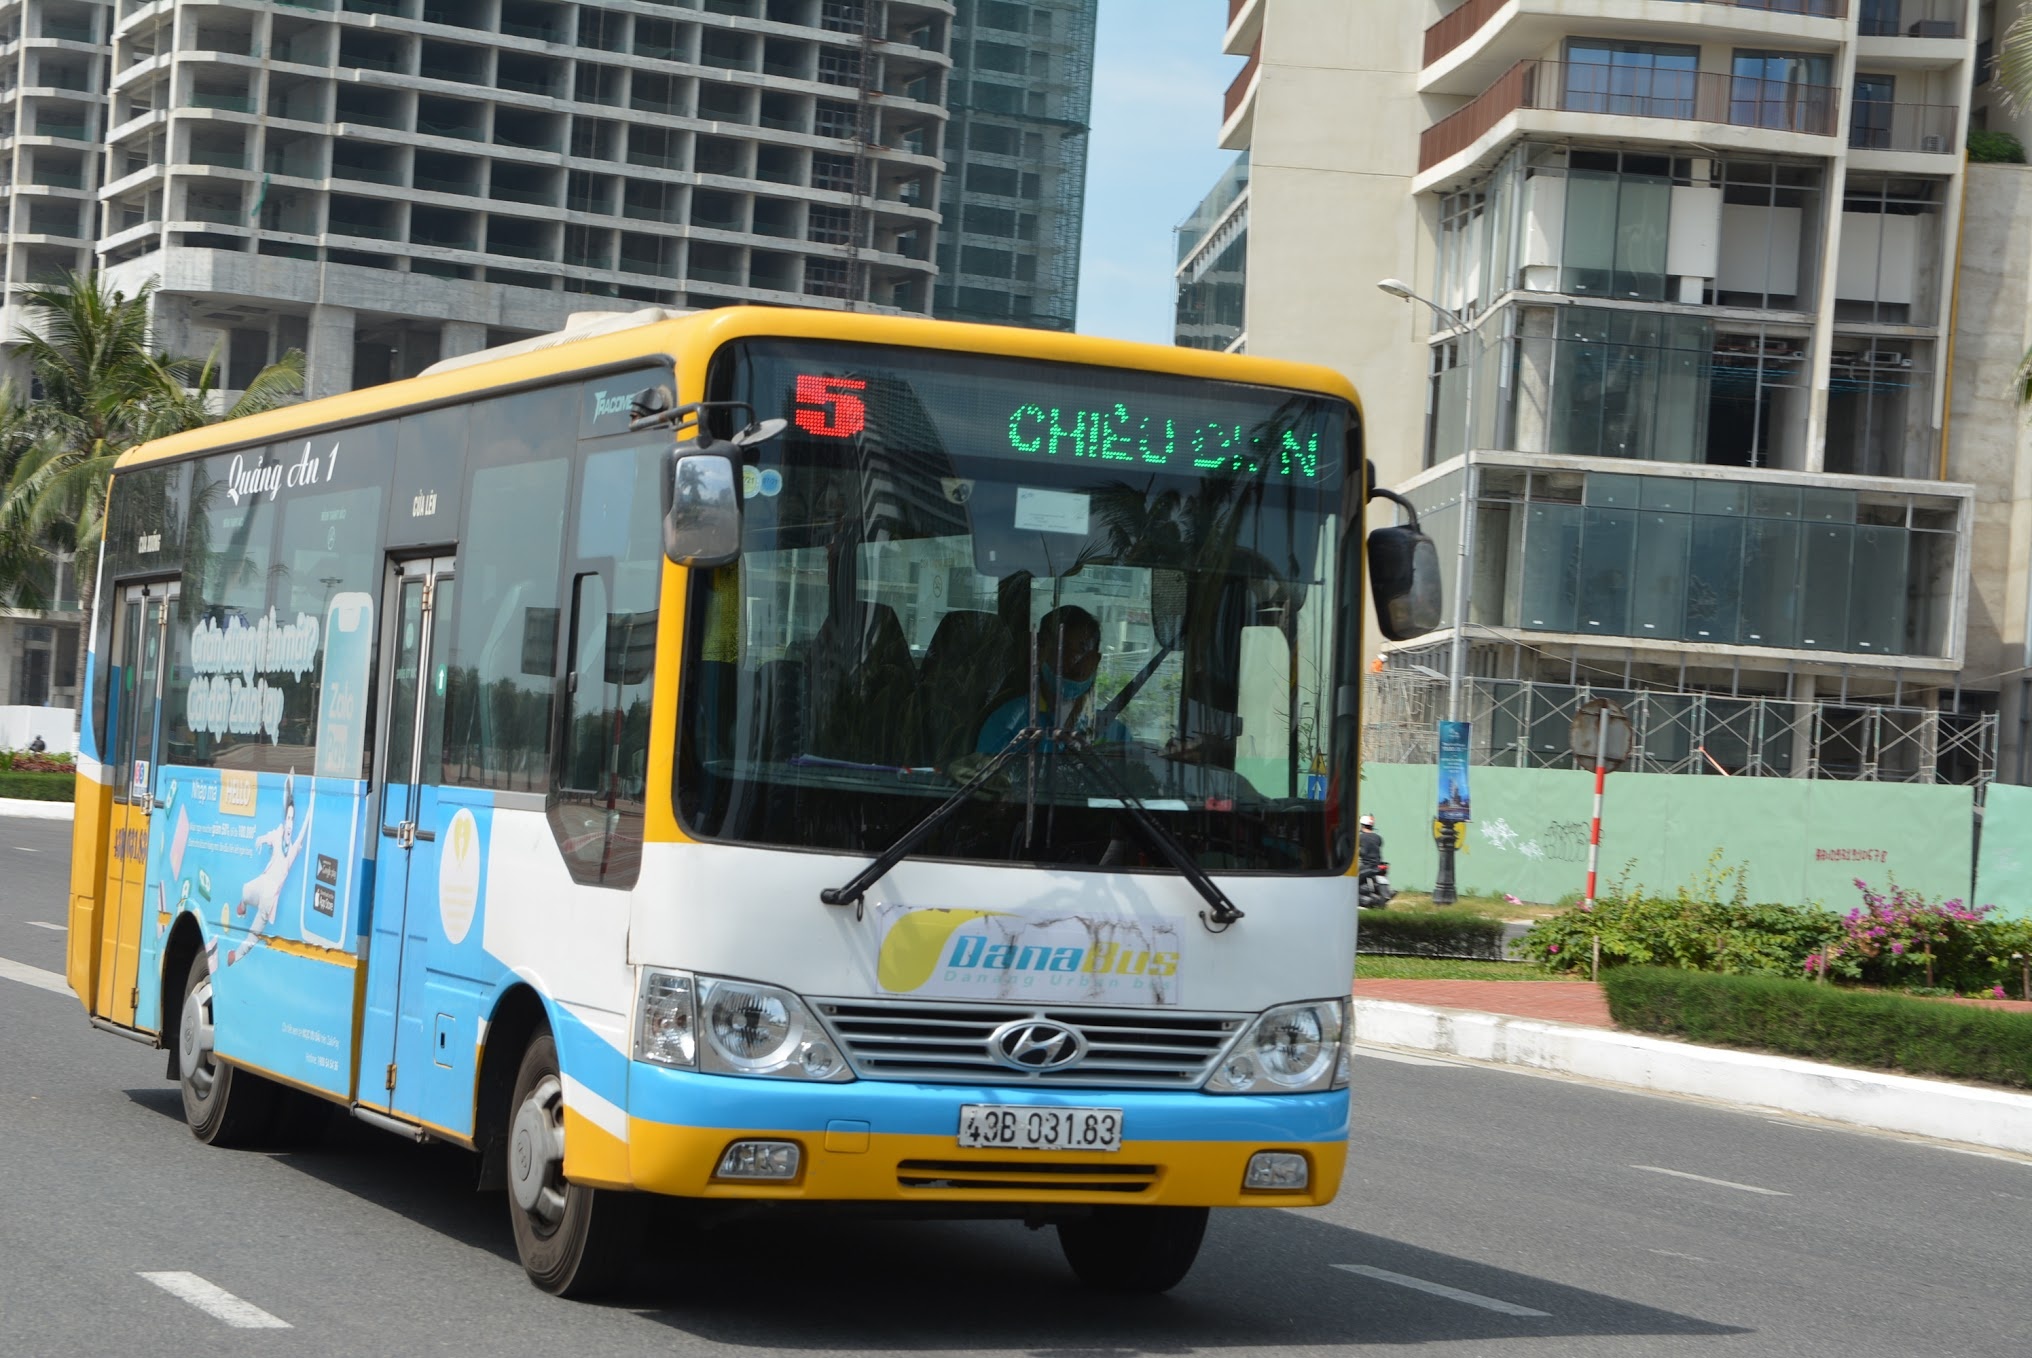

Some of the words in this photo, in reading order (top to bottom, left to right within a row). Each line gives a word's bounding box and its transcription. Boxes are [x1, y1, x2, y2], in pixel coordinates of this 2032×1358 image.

[796, 375, 866, 438] 5
[326, 441, 340, 482] 1
[226, 779, 251, 806] HELLO
[1027, 1112, 1116, 1145] 031.83
